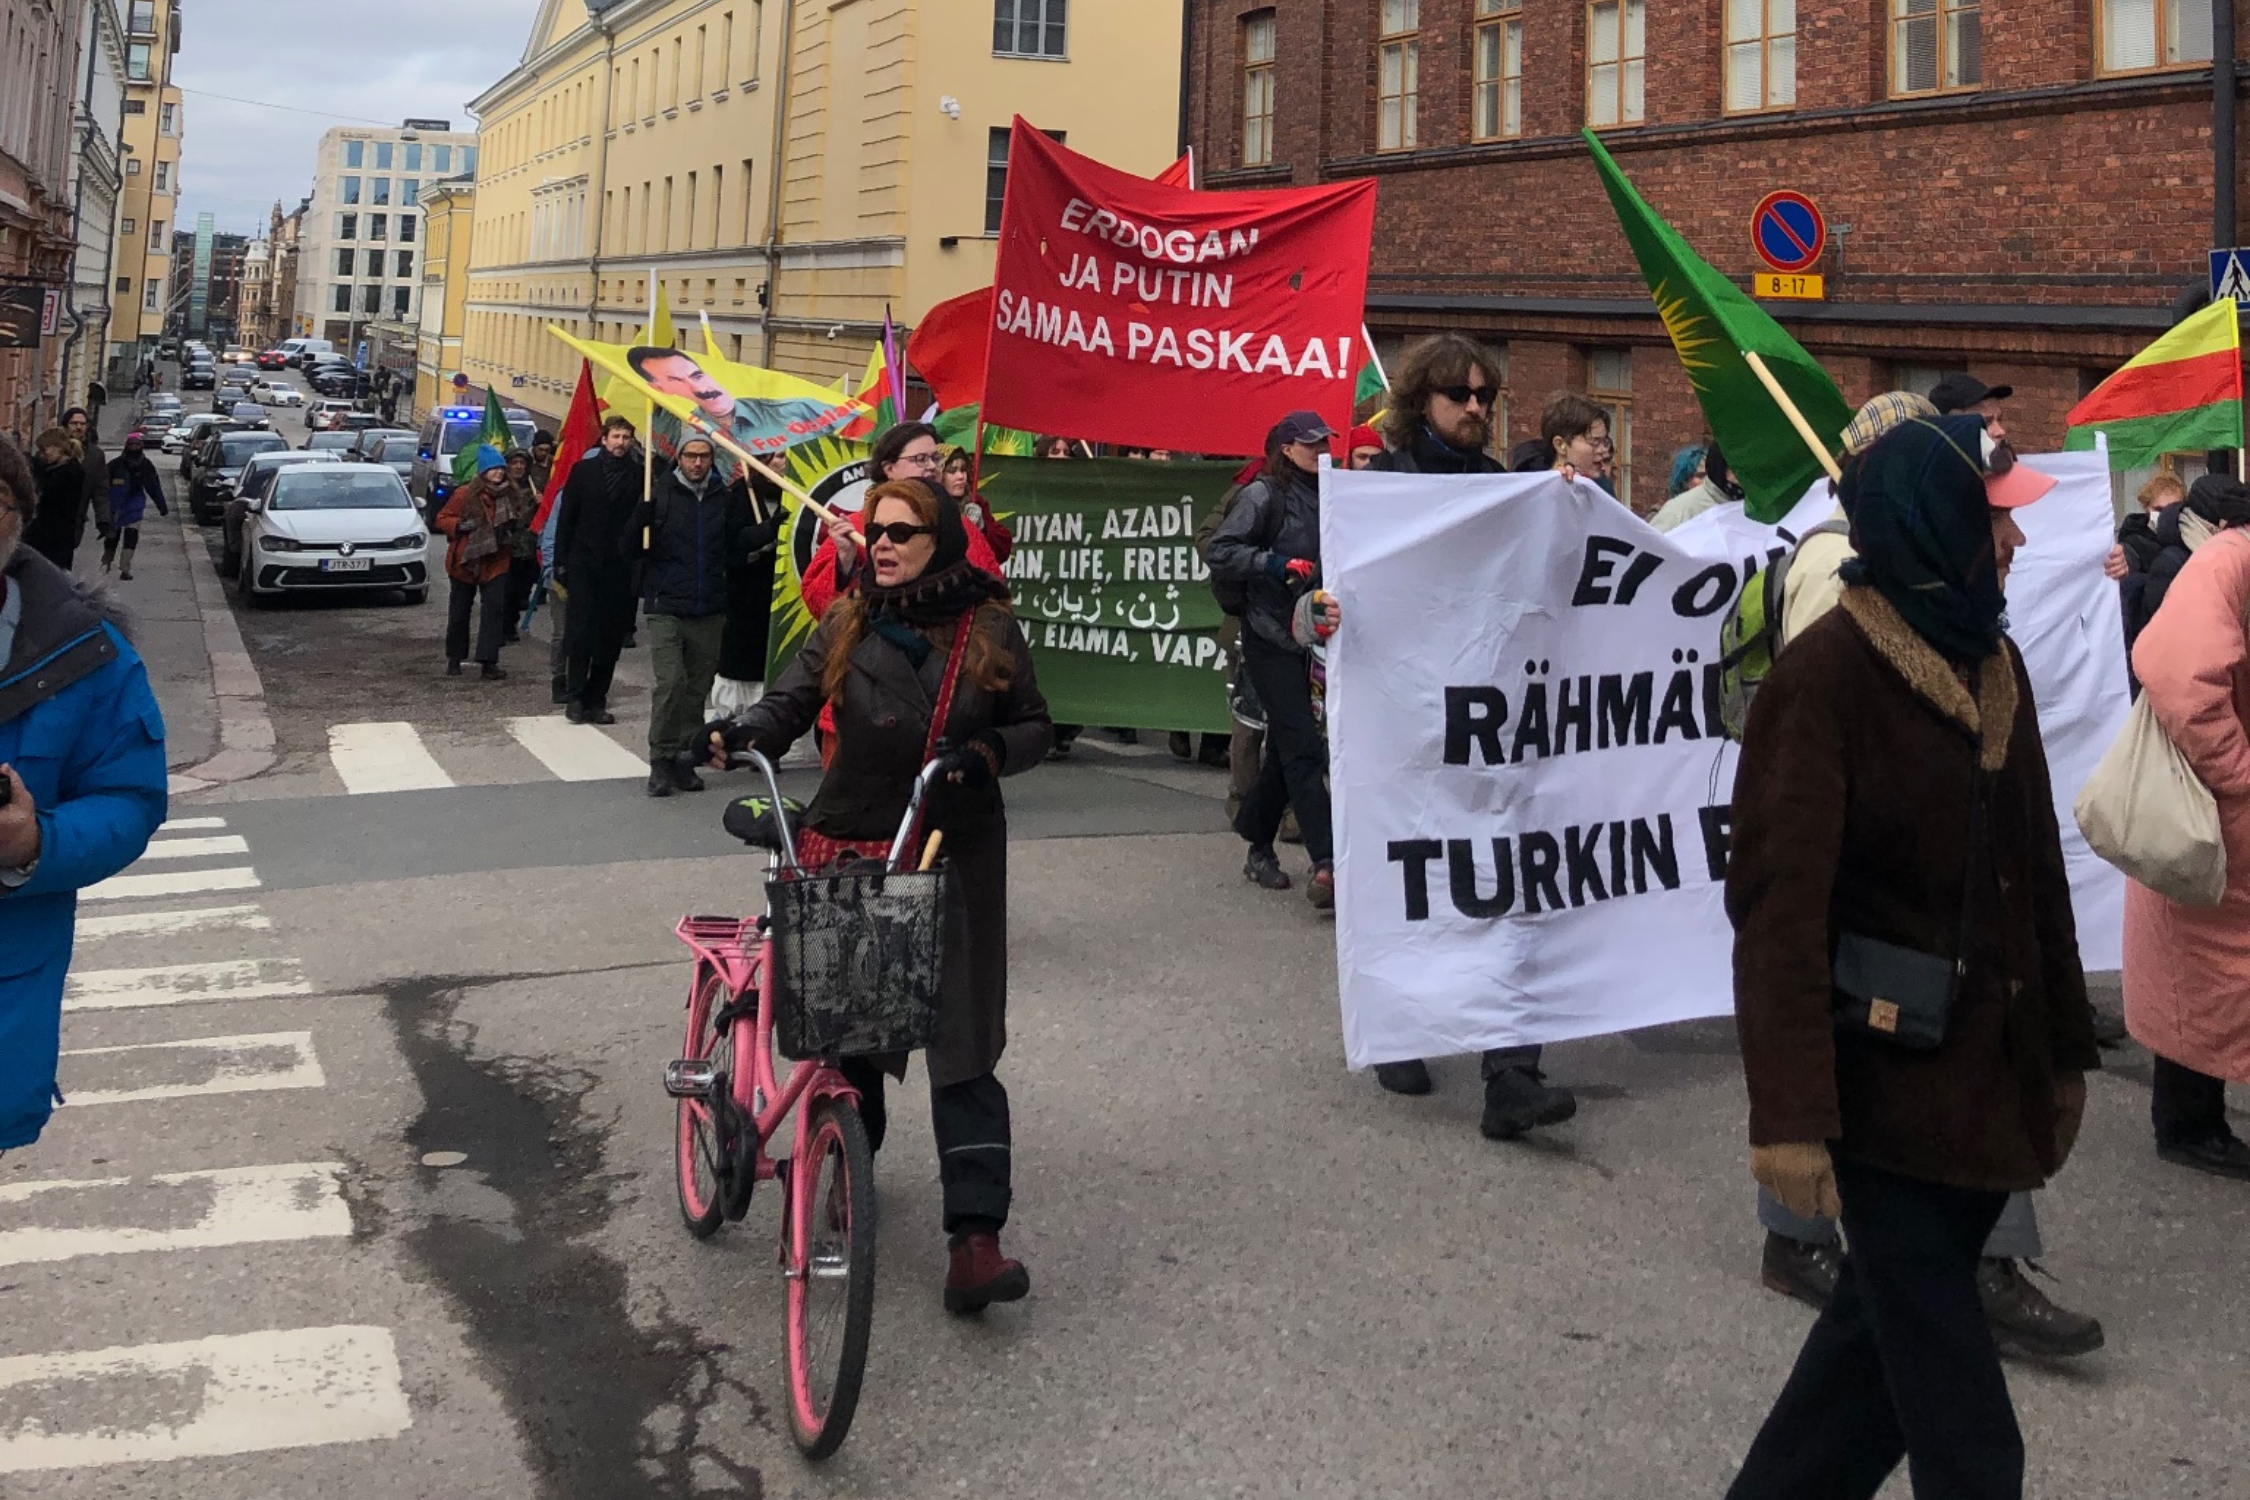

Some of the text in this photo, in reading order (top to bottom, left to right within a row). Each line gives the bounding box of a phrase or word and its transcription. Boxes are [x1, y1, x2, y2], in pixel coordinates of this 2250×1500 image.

[1060, 198, 1259, 263] ERDOGAN
[1059, 254, 1233, 308] JA PUTIN
[996, 288, 1352, 380] SAMAA PASKAA!
[1012, 495, 1194, 545] JIYAN, AZADÎ
[1058, 548, 1113, 584] LIFE,
[1571, 535, 1665, 607] EI
[1387, 813, 1680, 921] TURKIN
